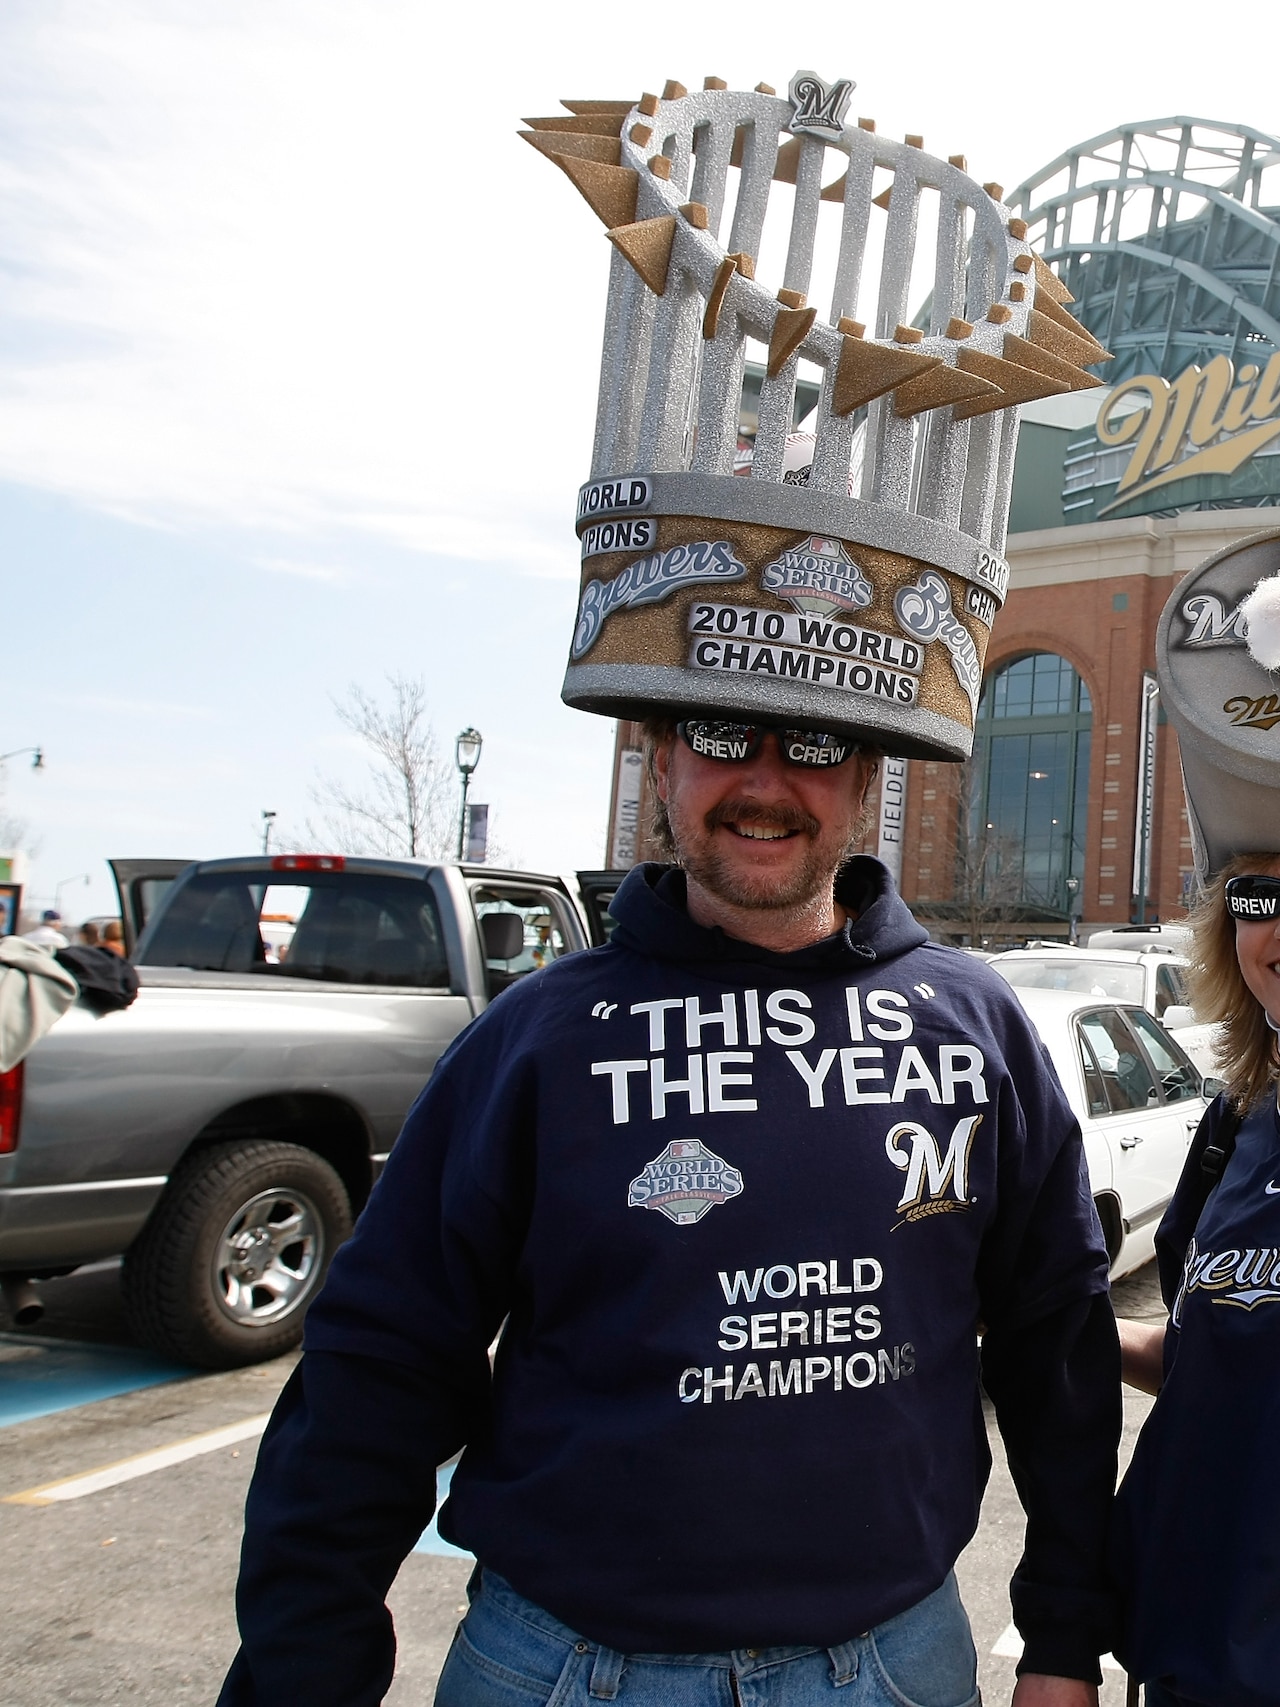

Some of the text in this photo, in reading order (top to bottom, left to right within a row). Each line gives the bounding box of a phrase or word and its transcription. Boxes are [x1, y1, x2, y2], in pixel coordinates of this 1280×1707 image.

[794, 76, 852, 131] M
[579, 480, 648, 516] WORLD
[584, 520, 651, 554] PIONS
[762, 562, 873, 608] SERIES
[783, 551, 861, 582] WORLD
[573, 540, 747, 657] Brewers
[692, 605, 919, 670] 2010 WORLD
[695, 640, 914, 694] CHAMPIONS
[691, 734, 846, 766] BREW CREW
[617, 799, 640, 859] BRAUN
[1231, 896, 1277, 915] BREW
[591, 1044, 990, 1125] THE YEAR
[631, 1170, 741, 1202] SERIES
[647, 1159, 725, 1179] WORLD
[885, 1113, 984, 1213] M
[717, 1257, 884, 1306] WORLD
[717, 1304, 882, 1352] SERIES
[678, 1341, 916, 1404] CHAMPIONS
